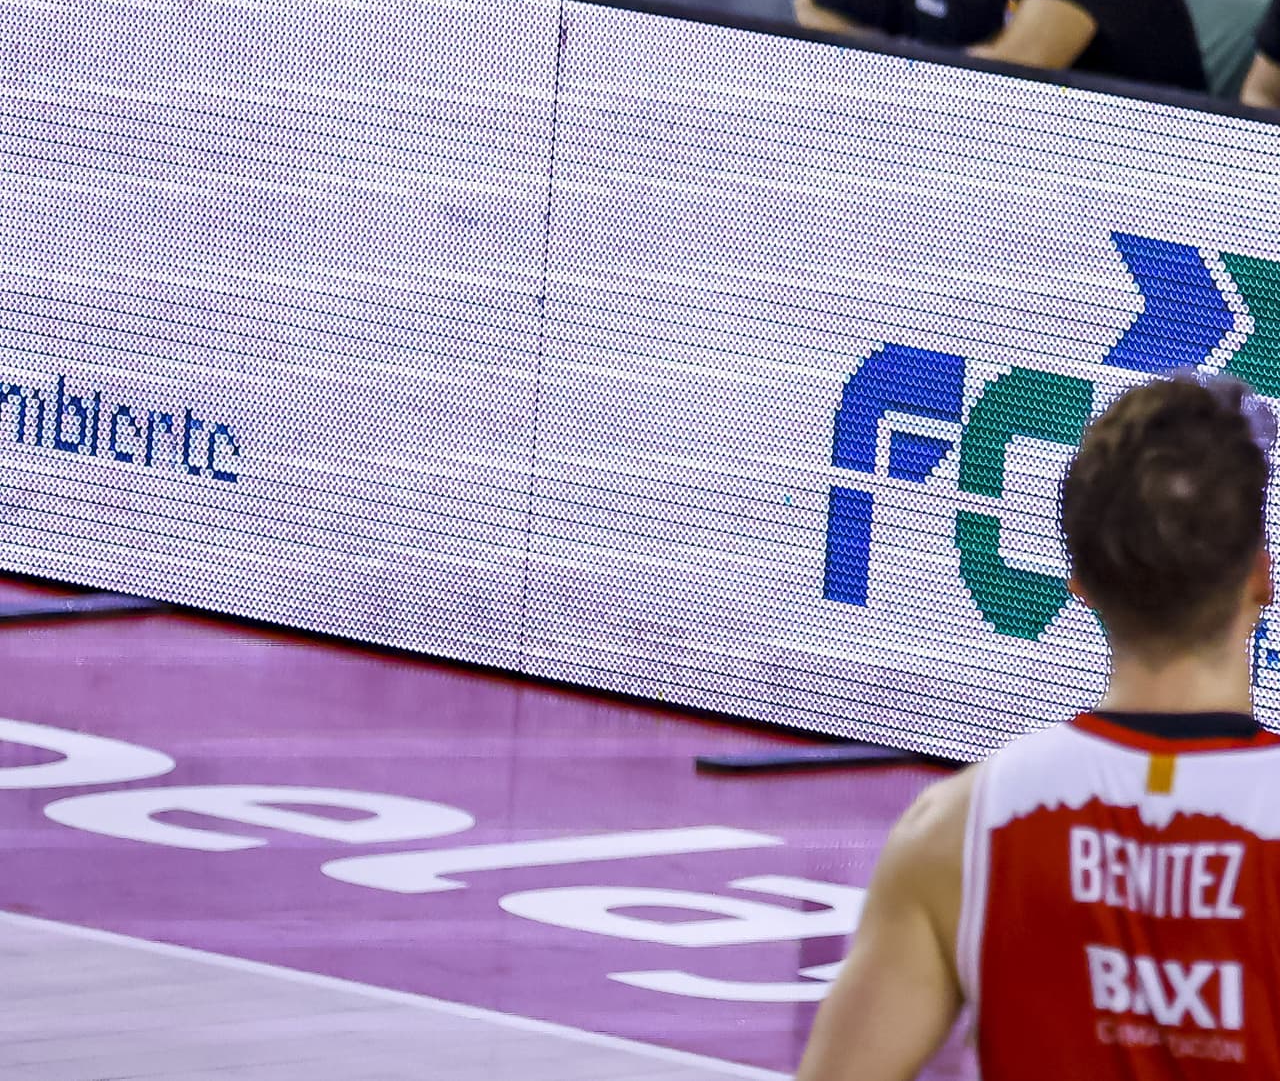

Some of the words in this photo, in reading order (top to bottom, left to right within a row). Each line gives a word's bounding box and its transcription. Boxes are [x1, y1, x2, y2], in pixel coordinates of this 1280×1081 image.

[822, 341, 1094, 642] FC
[1069, 826, 1245, 919] BENITEZ
[1084, 944, 1244, 1031] BAXI
